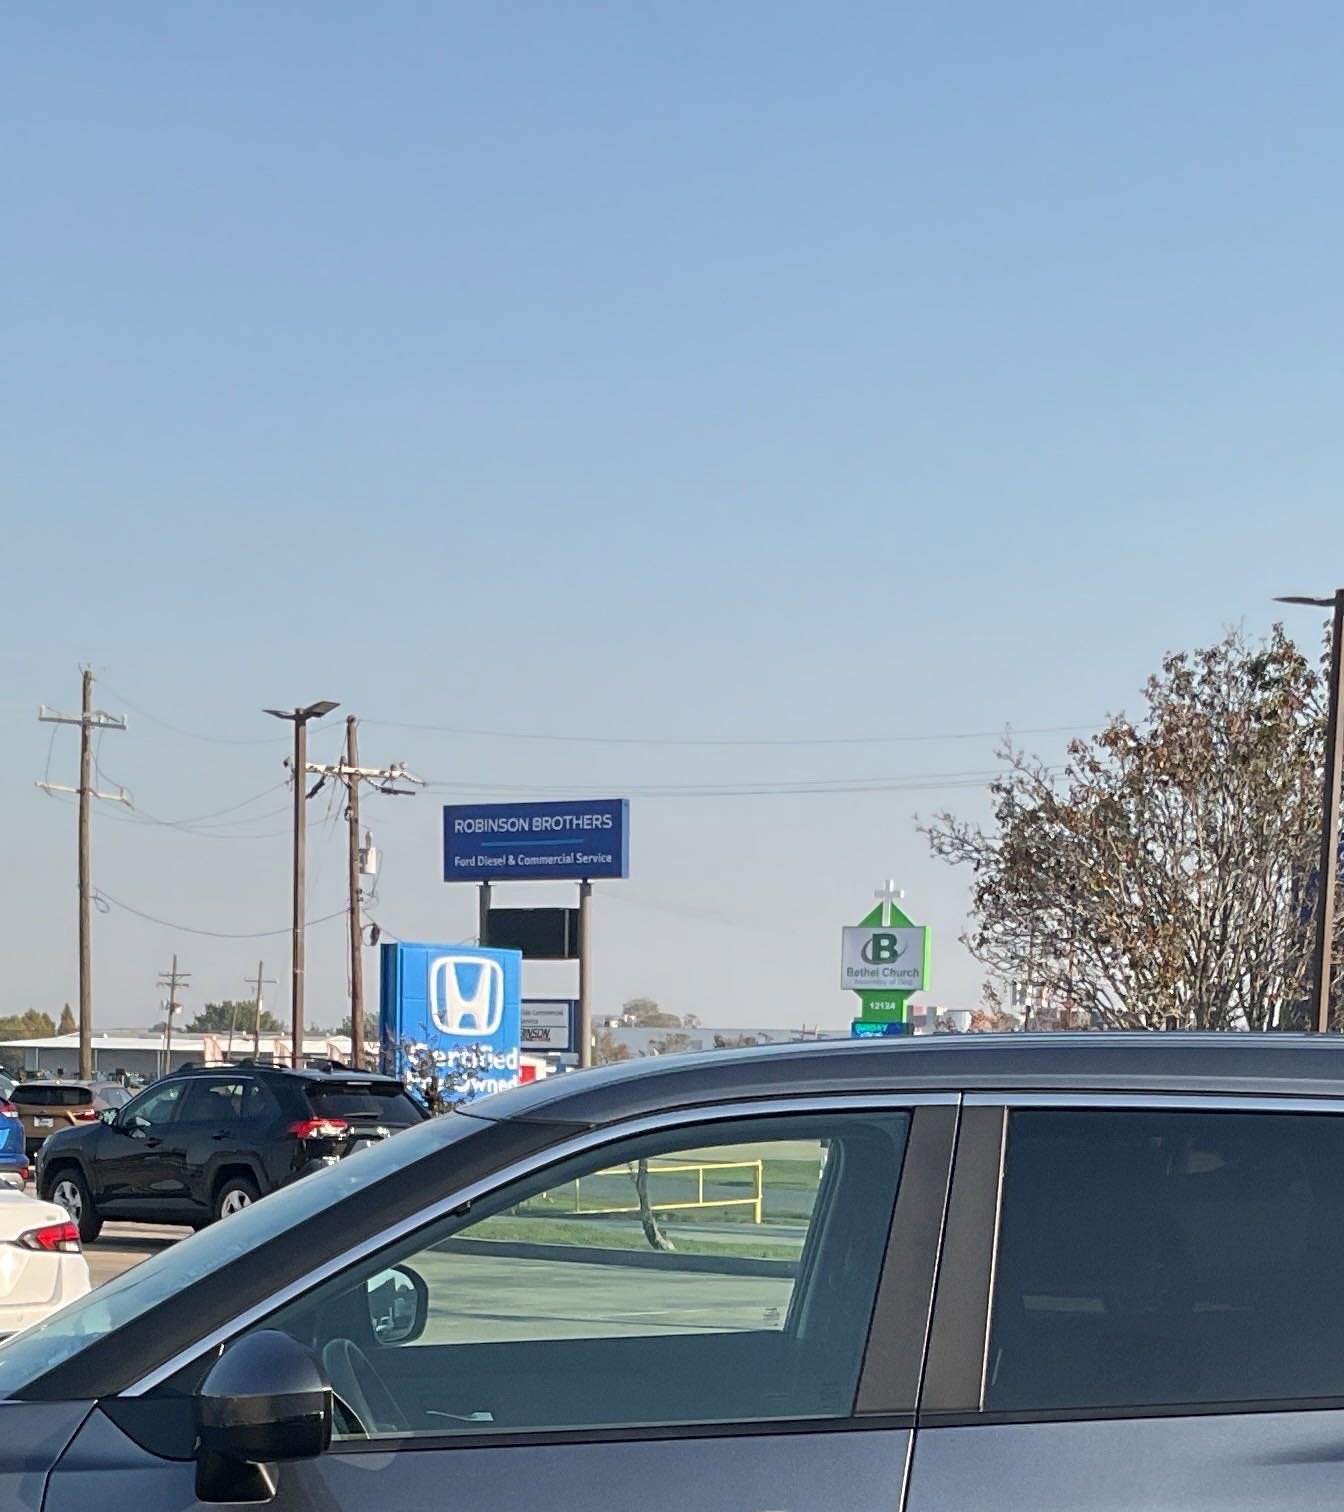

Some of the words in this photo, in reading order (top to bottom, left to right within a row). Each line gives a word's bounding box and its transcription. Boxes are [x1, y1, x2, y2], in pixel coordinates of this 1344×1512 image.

[454, 818, 529, 833] ROBINSON
[532, 814, 613, 830] BROTHERS
[454, 856, 476, 867] Ford
[477, 855, 506, 866] Diesel
[507, 854, 516, 865] &
[517, 852, 575, 865] Commercial
[576, 852, 612, 864] Service
[847, 967, 879, 977] Bethel
[882, 967, 920, 977] Church
